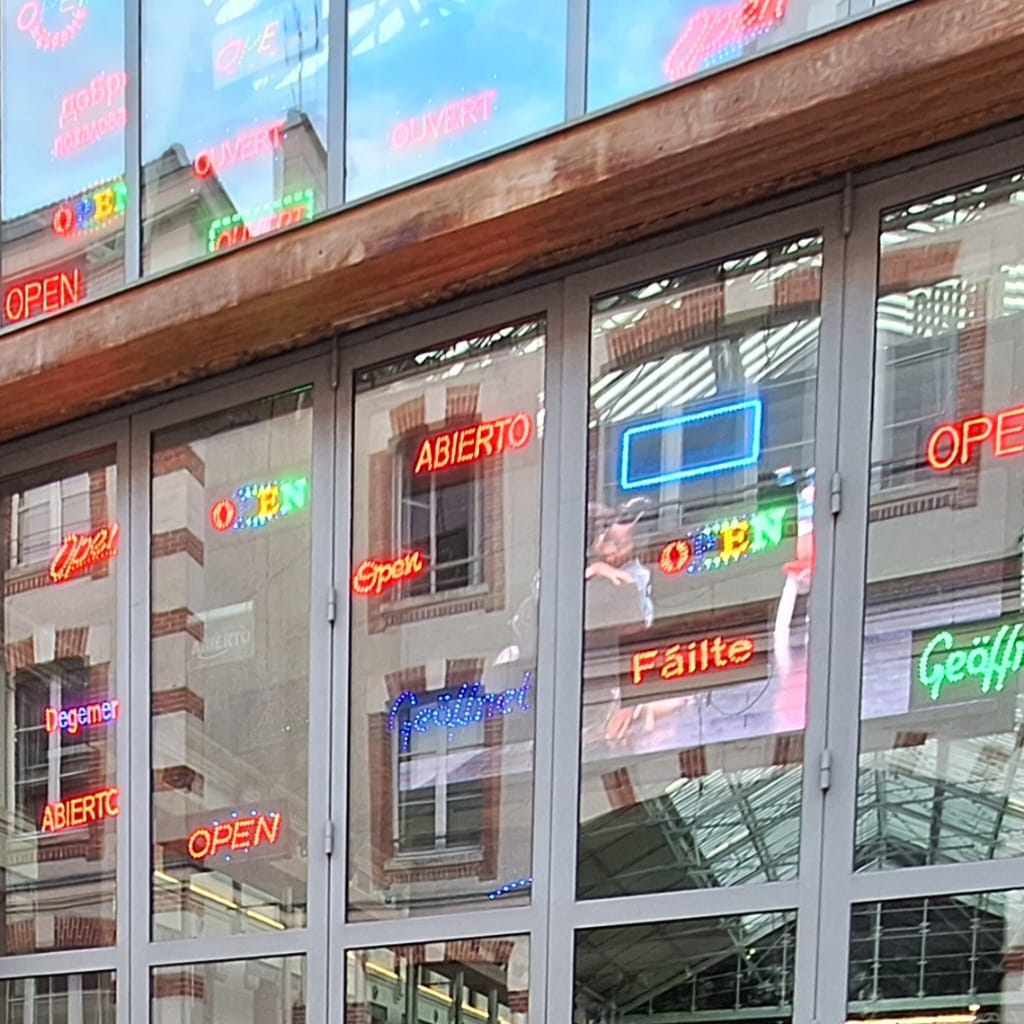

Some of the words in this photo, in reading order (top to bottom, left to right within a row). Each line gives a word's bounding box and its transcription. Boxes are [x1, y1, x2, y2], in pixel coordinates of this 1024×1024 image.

[195, 119, 285, 176] OUVERT
[391, 91, 494, 148] OUVERT
[5, 267, 79, 321] OPEN
[414, 412, 533, 474] ABIERTO
[927, 406, 1024, 470] OPE
[660, 507, 787, 574] OPEN
[353, 550, 424, 595] Open
[632, 636, 755, 684] Fáilte
[45, 699, 120, 734] Degemer
[387, 671, 533, 752] Geöffnet
[188, 812, 281, 860] OPEN
